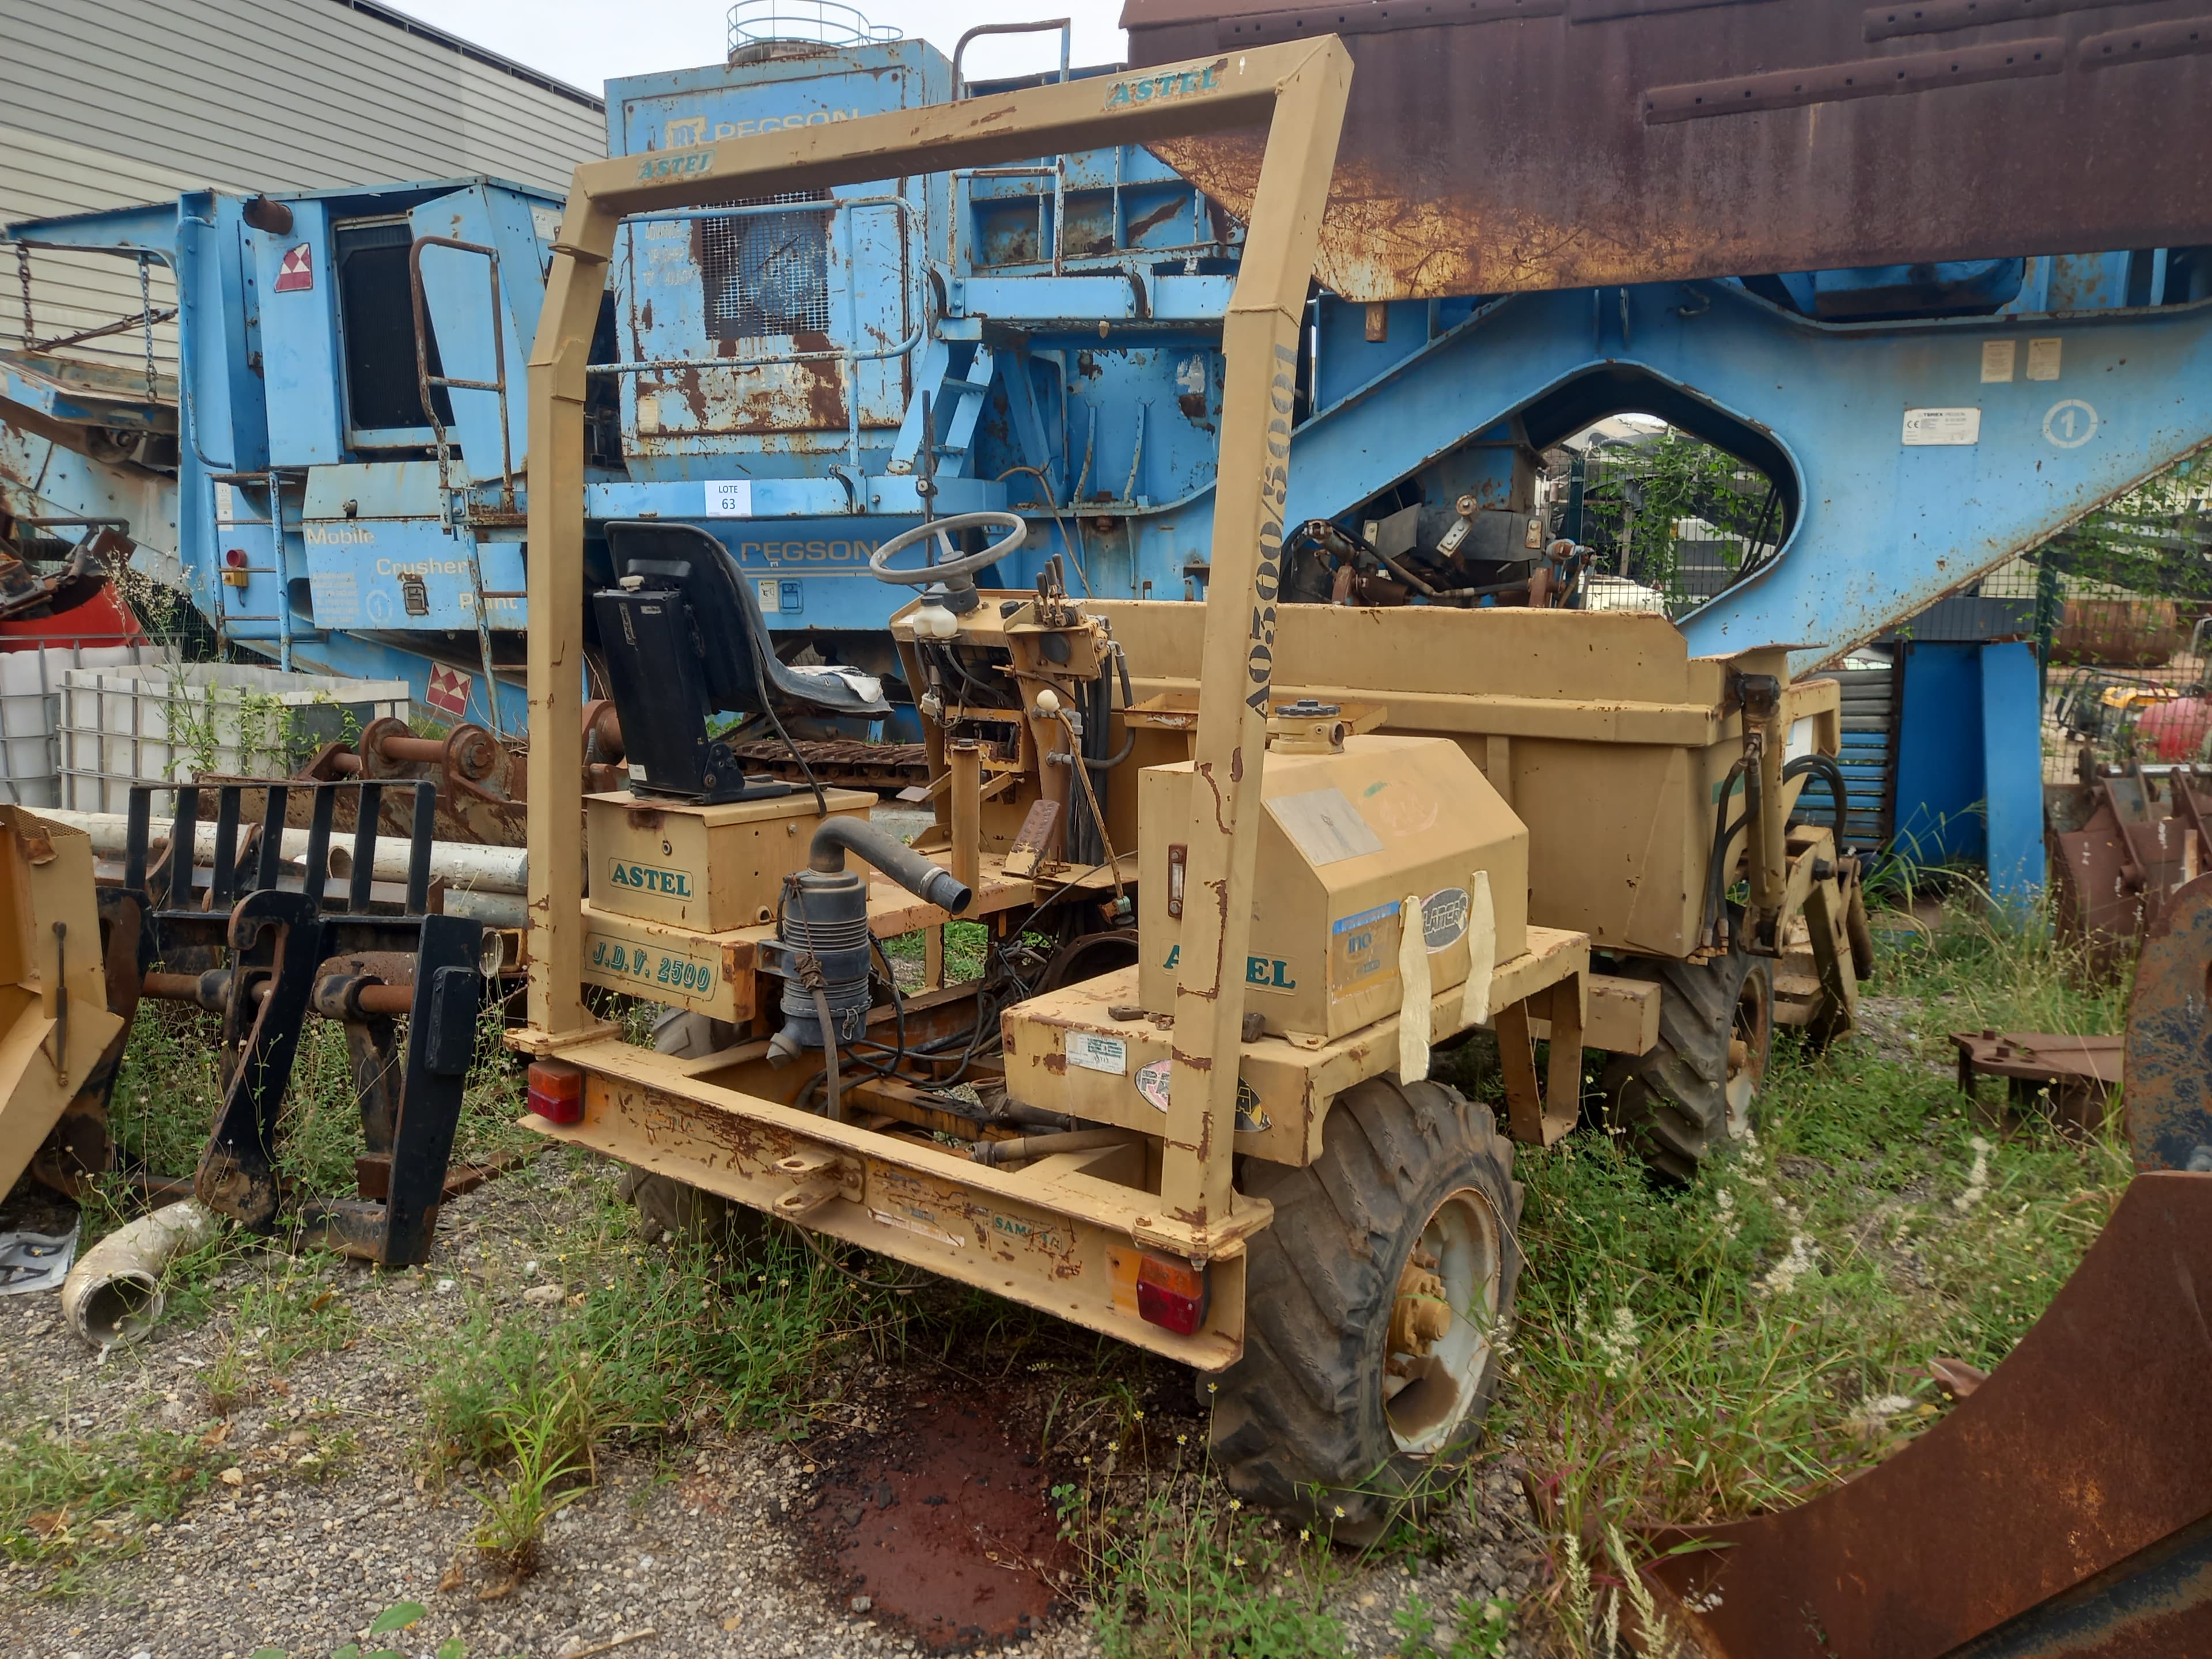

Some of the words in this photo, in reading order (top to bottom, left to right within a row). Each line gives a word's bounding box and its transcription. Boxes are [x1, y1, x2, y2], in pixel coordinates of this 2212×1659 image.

[1109, 69, 1219, 104] ASTEL
[718, 485, 738, 494] LOTE
[722, 498, 736, 510] 63
[305, 528, 376, 544] Mobile
[741, 540, 880, 562] PEGSON
[376, 556, 468, 575] Crusher
[459, 593, 518, 610] Pant
[612, 863, 691, 897] ASTEL
[593, 941, 650, 979] J.D.V.
[657, 957, 711, 992] 2500
[1163, 944, 1296, 990] AEL
